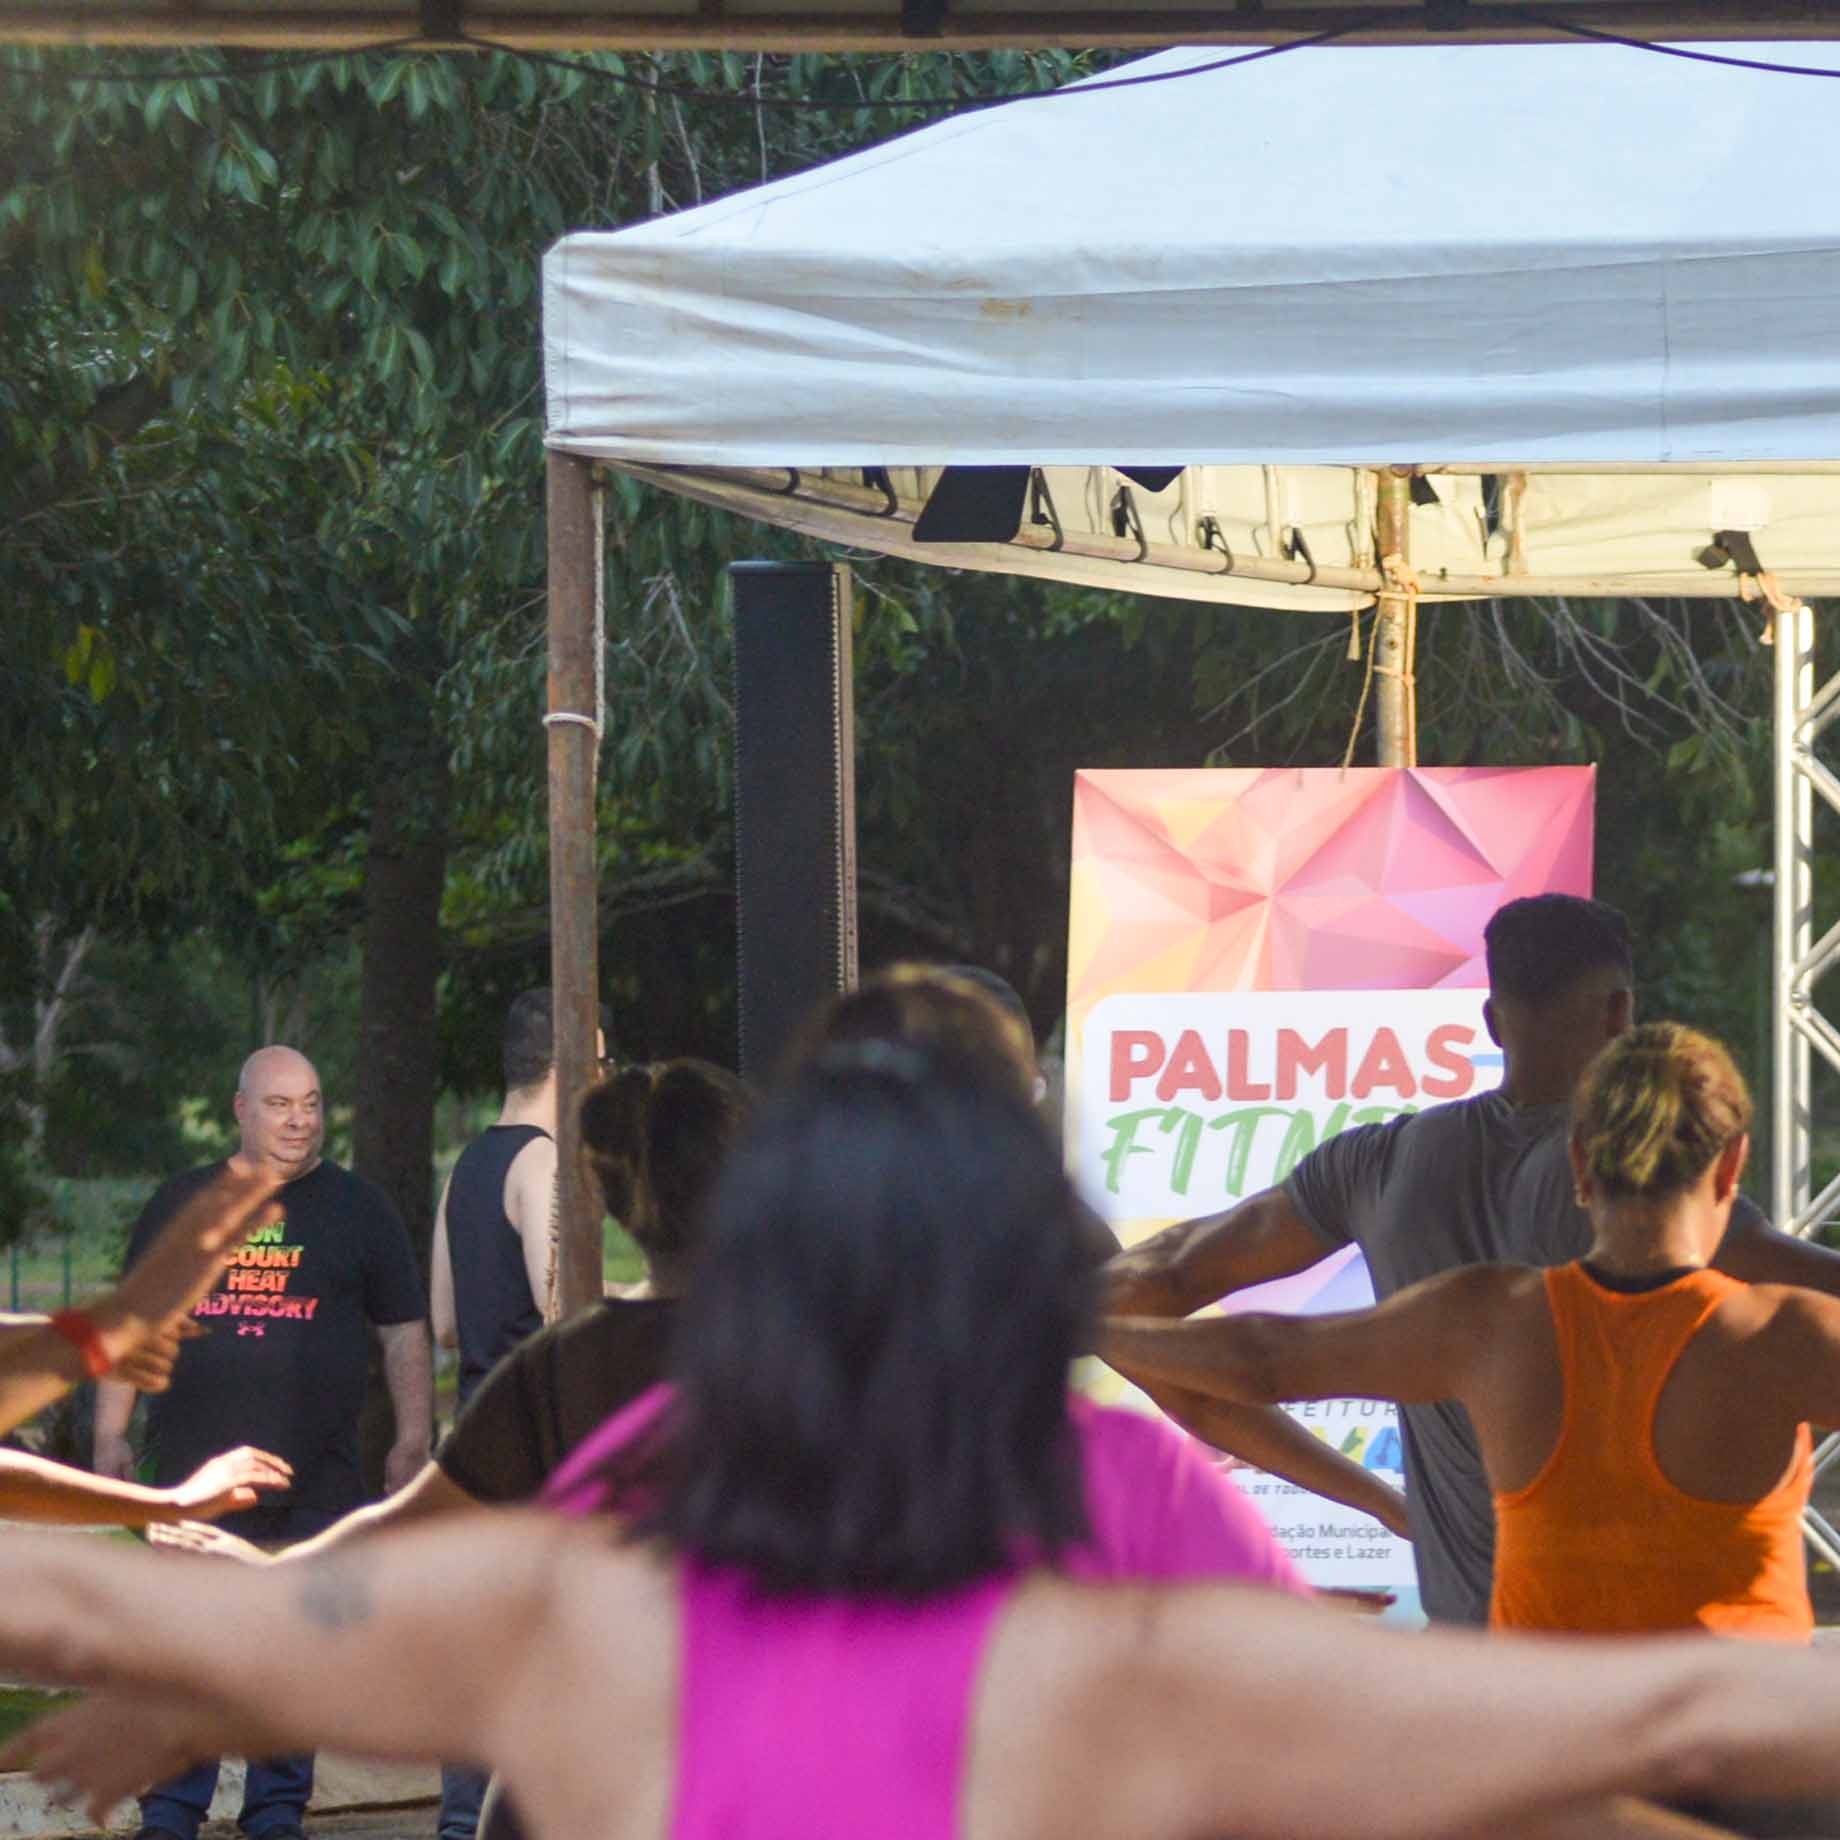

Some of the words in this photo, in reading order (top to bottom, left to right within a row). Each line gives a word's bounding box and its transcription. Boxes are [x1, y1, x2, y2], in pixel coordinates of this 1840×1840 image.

[1109, 1023, 1477, 1102] PALMAS
[227, 1269, 290, 1292] HEAT
[193, 1293, 320, 1320] ADVISORY
[1347, 1547, 1392, 1560] Lazer
